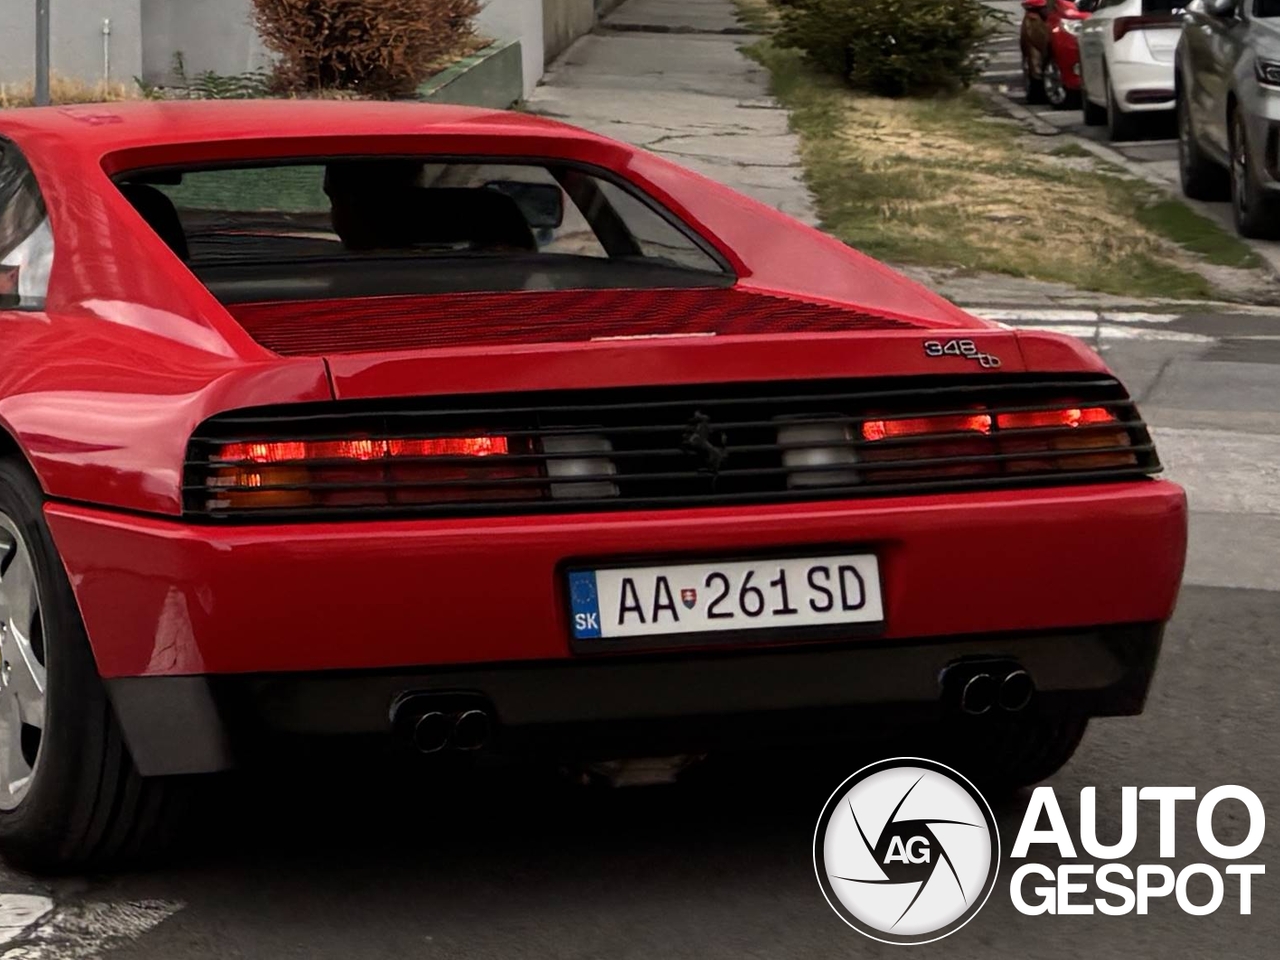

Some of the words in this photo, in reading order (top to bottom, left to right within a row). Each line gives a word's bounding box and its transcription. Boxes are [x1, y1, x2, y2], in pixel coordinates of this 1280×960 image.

[924, 339, 977, 356] 348
[617, 575, 680, 626] AA
[575, 612, 598, 630] SK
